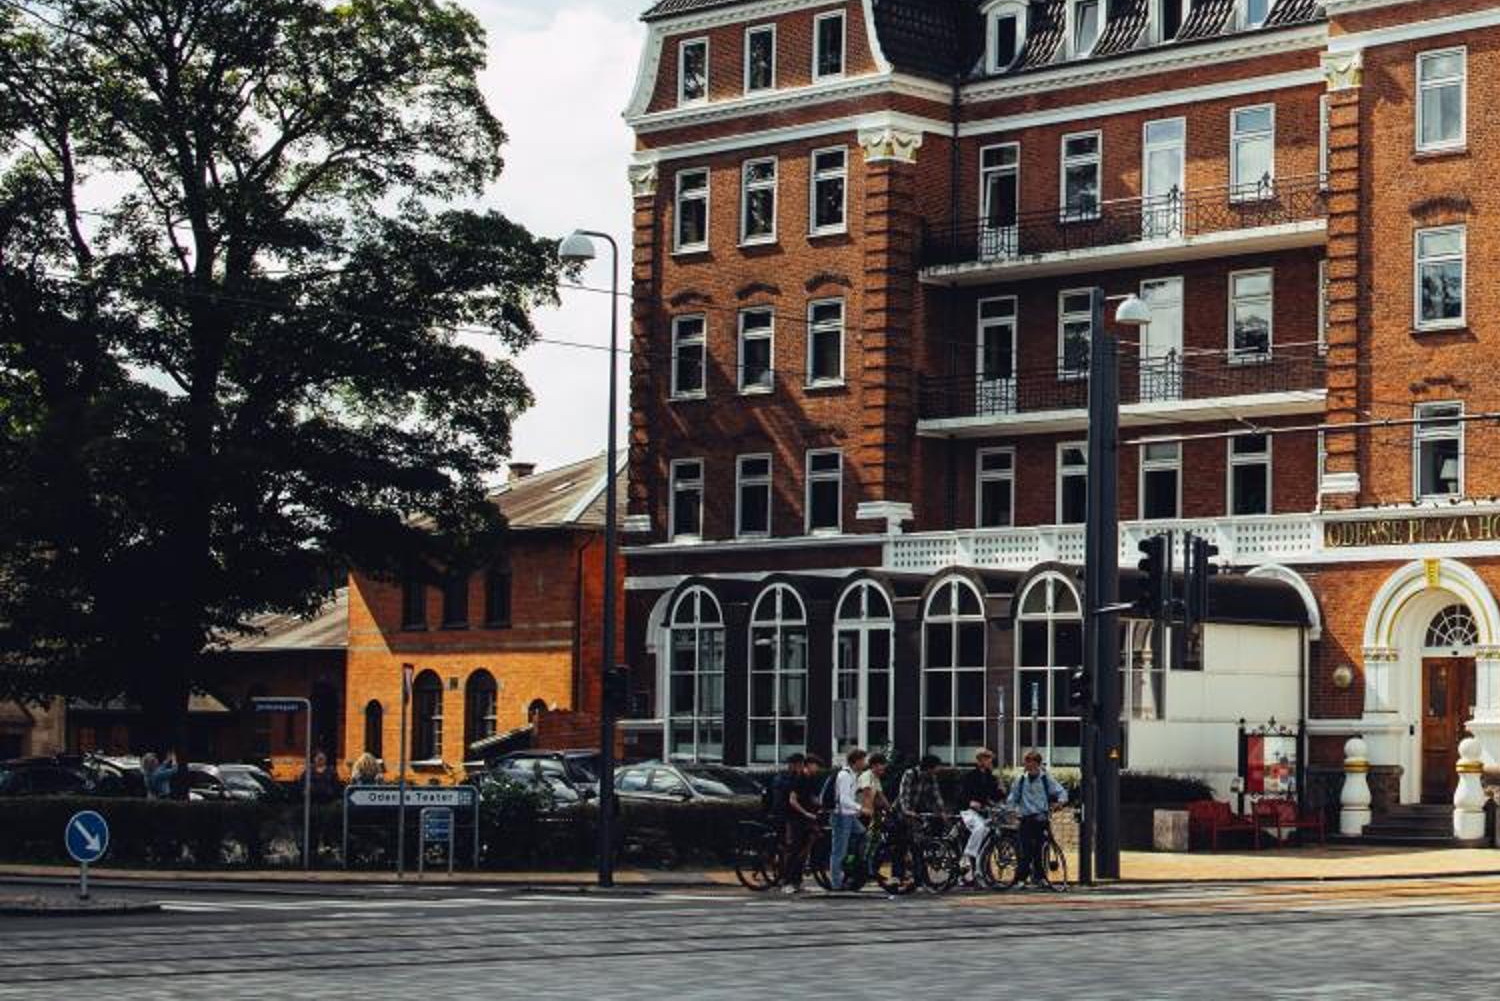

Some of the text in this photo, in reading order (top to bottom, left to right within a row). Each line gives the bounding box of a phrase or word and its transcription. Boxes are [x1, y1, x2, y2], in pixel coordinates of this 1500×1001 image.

[1327, 520, 1403, 547] ODENSE
[1408, 516, 1474, 543] PLAZA
[368, 792, 454, 802] Odene Teater
